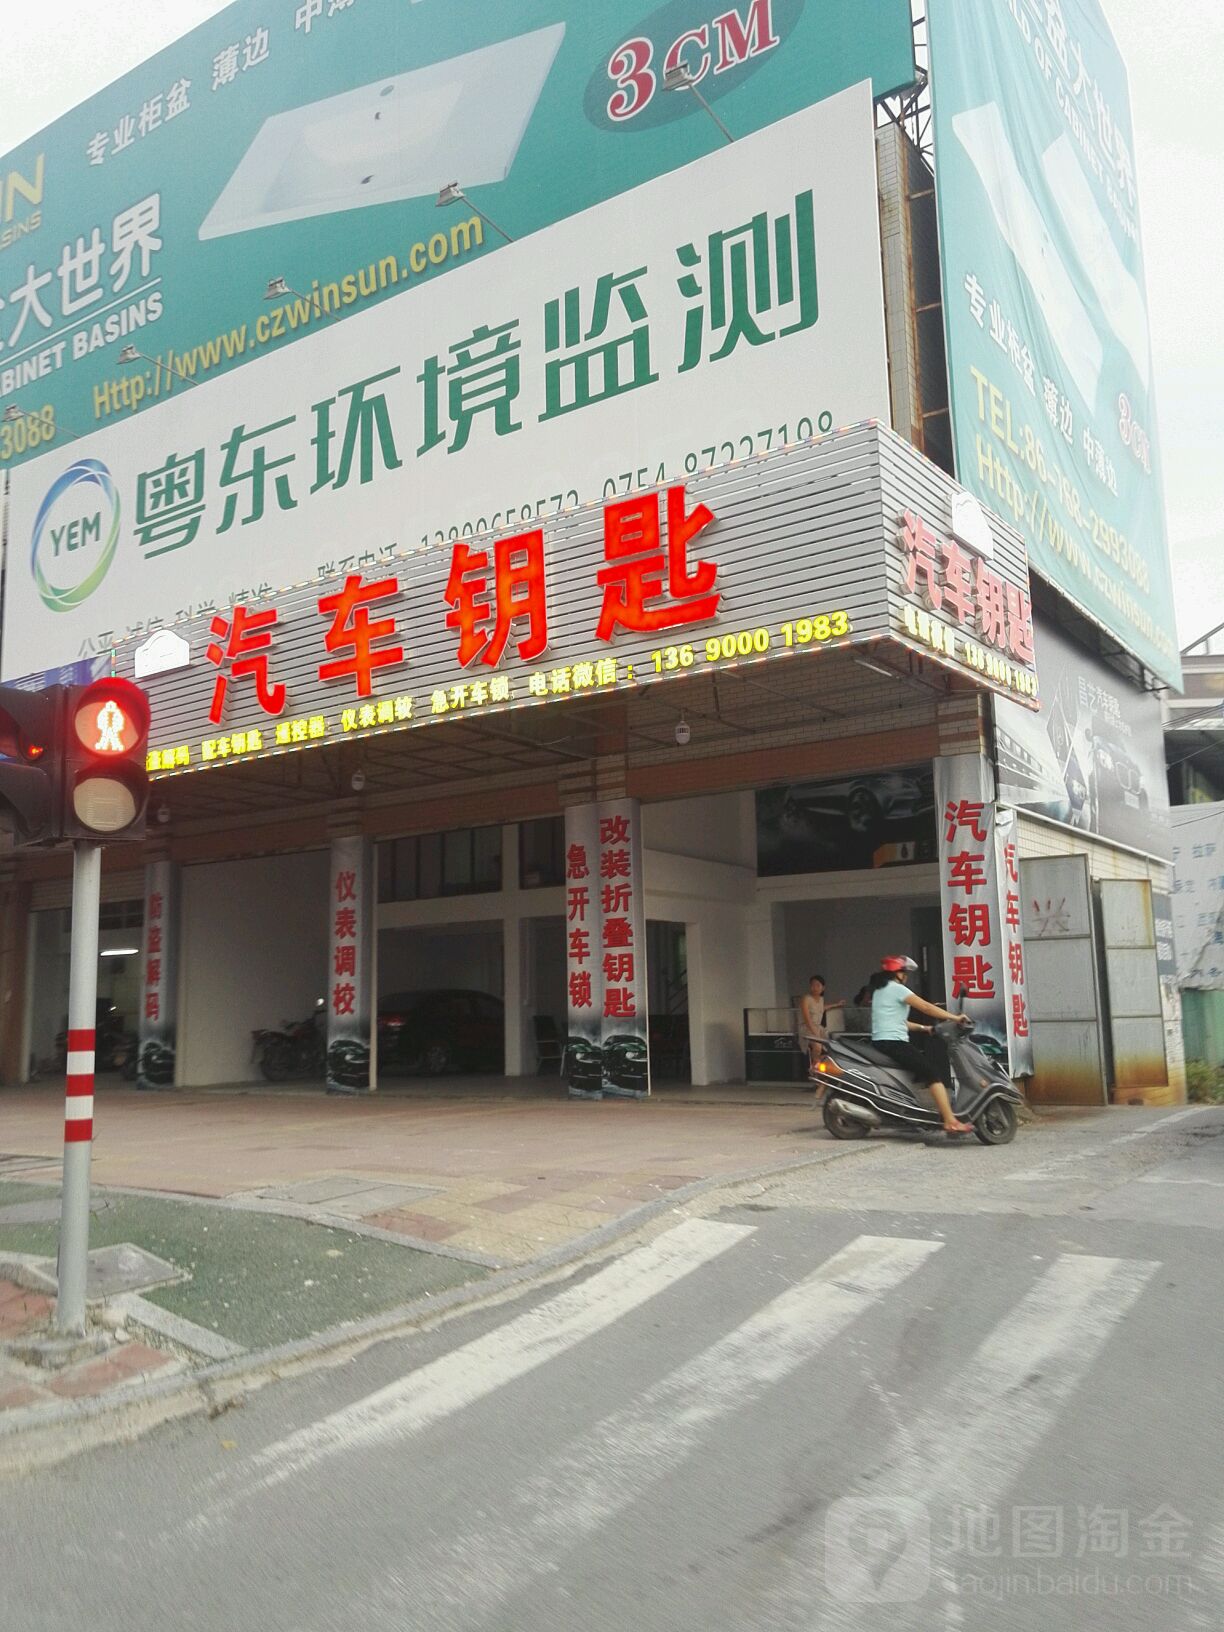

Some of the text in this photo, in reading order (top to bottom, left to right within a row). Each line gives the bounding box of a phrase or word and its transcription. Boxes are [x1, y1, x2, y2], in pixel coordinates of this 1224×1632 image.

[86, 77, 194, 166] 专业柜盆
[211, 27, 270, 91] 薄边
[0, 192, 163, 350] 大世界
[0, 290, 164, 399] BINET BASINS
[93, 215, 486, 421] Http://www.czwinsun.com
[133, 189, 820, 560] 粤东环境监测
[50, 511, 101, 557] YEM
[206, 484, 722, 725] 汽车钥匙
[902, 508, 1034, 665] 汽车钥匙
[430, 676, 510, 715] 急开车锁
[651, 643, 695, 675] 136
[705, 627, 770, 662] 9000
[780, 610, 850, 648] 1983
[332, 870, 357, 1016] 仪表调校
[566, 843, 593, 1009] 急开车锁
[599, 814, 637, 1019] 改装折叠钥匙
[945, 799, 996, 1001] 汽车钥匙
[1003, 842, 1029, 1038] 汽车钥匙
